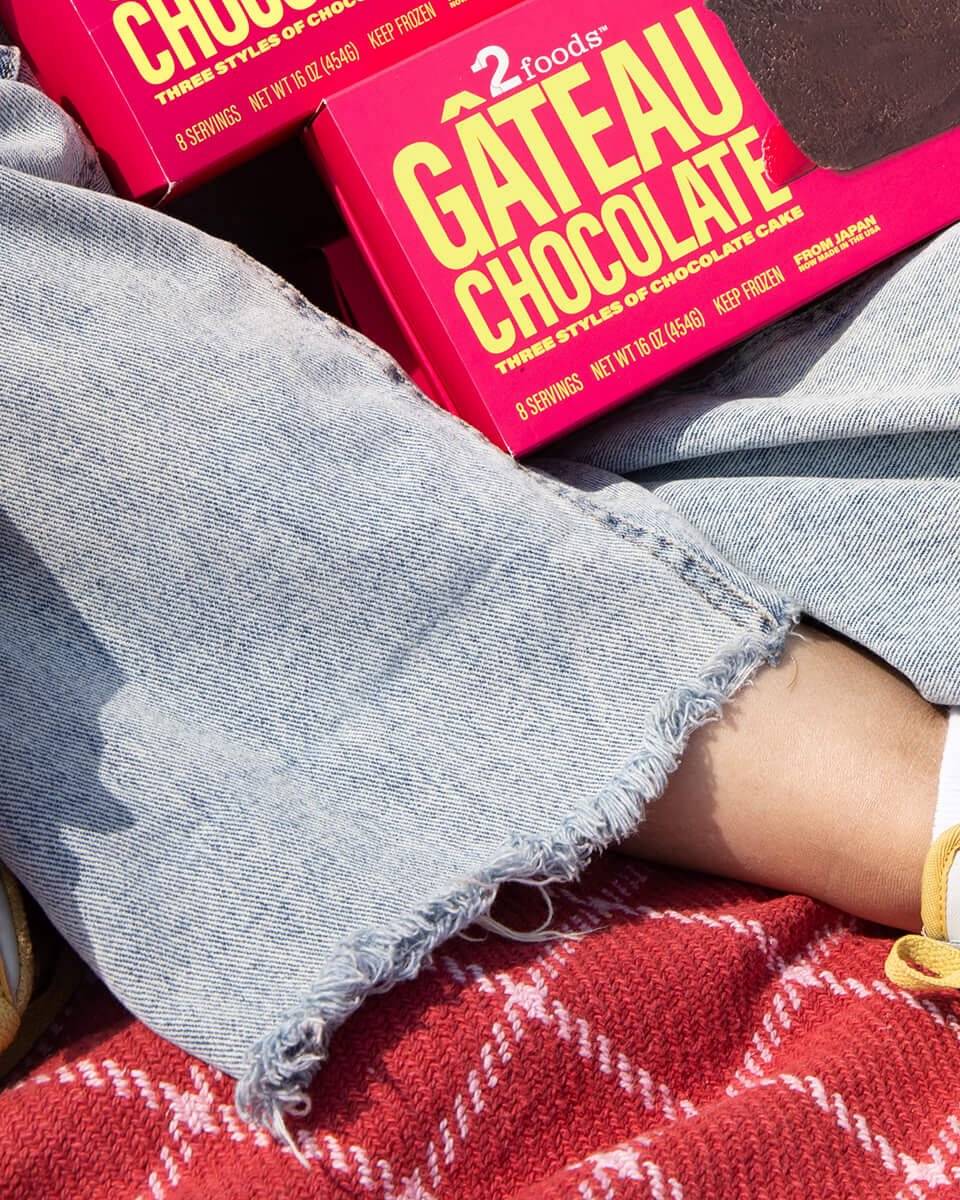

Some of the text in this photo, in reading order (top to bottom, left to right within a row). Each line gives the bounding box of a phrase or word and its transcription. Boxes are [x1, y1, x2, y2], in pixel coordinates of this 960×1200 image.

[153, 67, 215, 105] THREE
[213, 33, 281, 75] STYLES
[280, 19, 305, 40] OF
[175, 0, 437, 150] 8 SERVINGS NET WT 16 OZ (454G) KEEP FROZEN
[392, 6, 743, 270] GÂTEAU
[453, 124, 792, 354] CHOCOLATE
[494, 204, 804, 374] THREE STYLES OF CHOCOLATE CAKE
[793, 214, 876, 266] FROM JAPAN
[515, 265, 784, 420] 8 SERVINGS NET WT 16 OZ (454G) KEEP FROZEN
